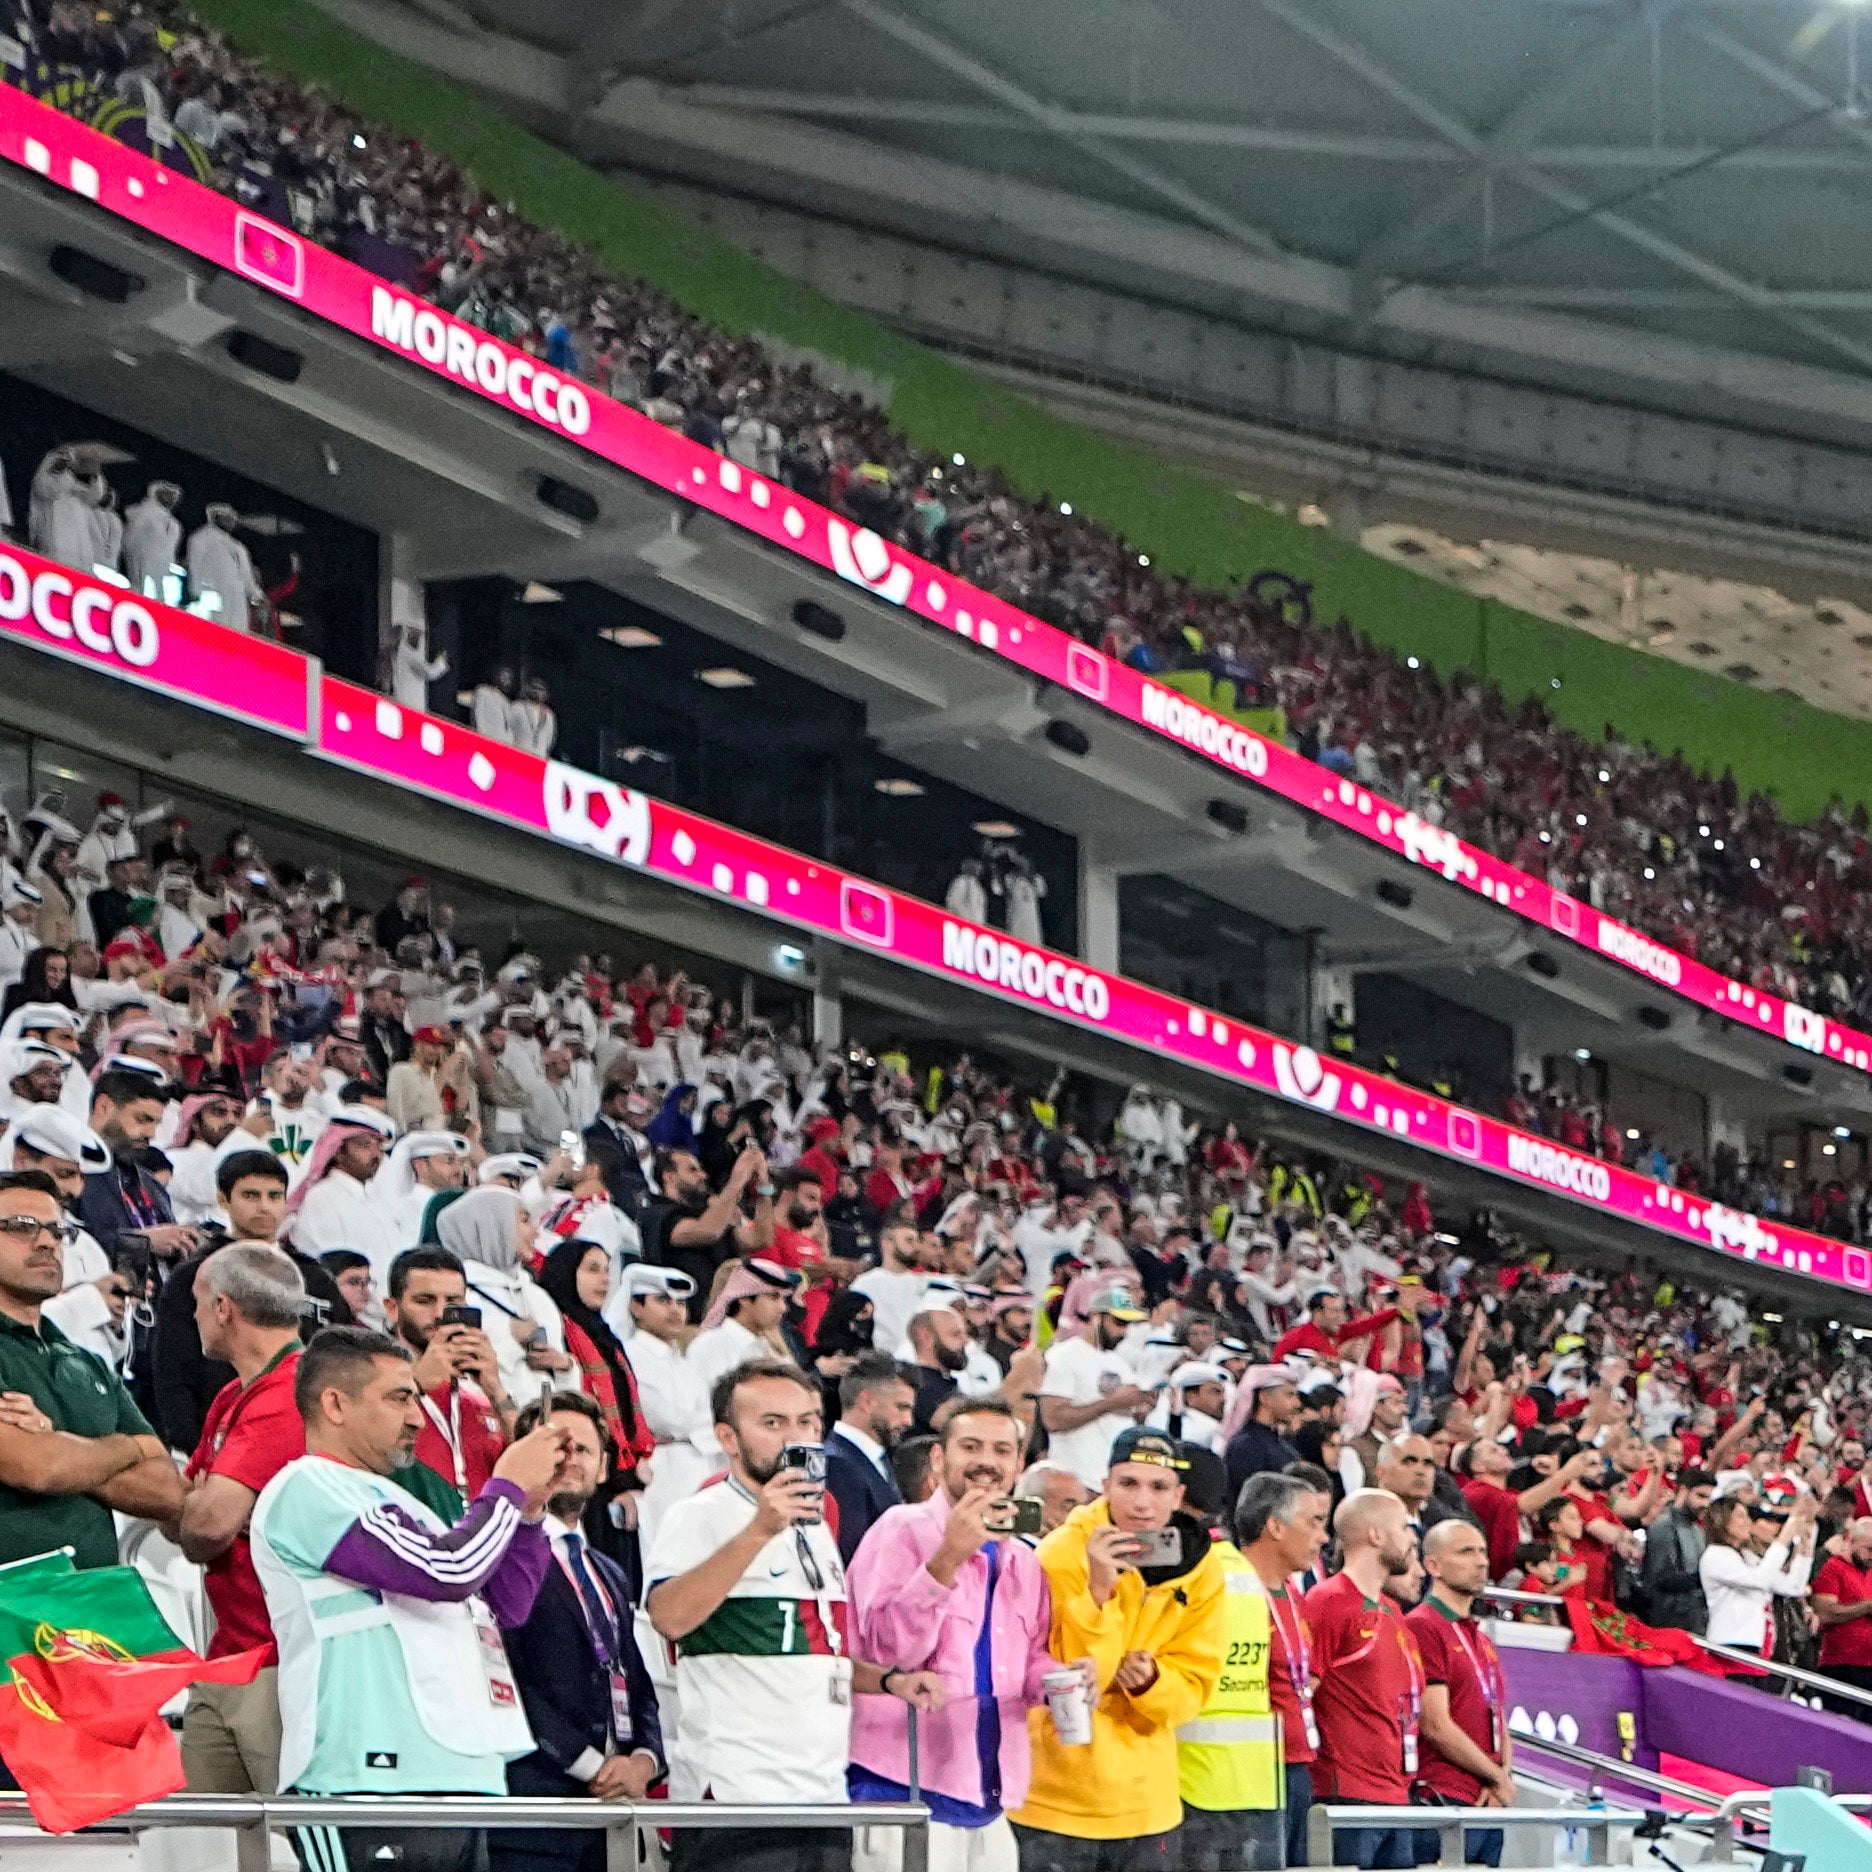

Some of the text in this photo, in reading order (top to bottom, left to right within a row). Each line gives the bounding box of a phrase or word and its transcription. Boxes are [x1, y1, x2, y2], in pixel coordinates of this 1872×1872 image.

[371, 284, 591, 437] MOROCCO
[0, 554, 160, 667] OCCO
[1143, 683, 1268, 778] MOROCCO
[942, 920, 1110, 1022] MOROCCO
[1598, 916, 1682, 987] MOROCCO
[1507, 1133, 1611, 1203] MOROCCO
